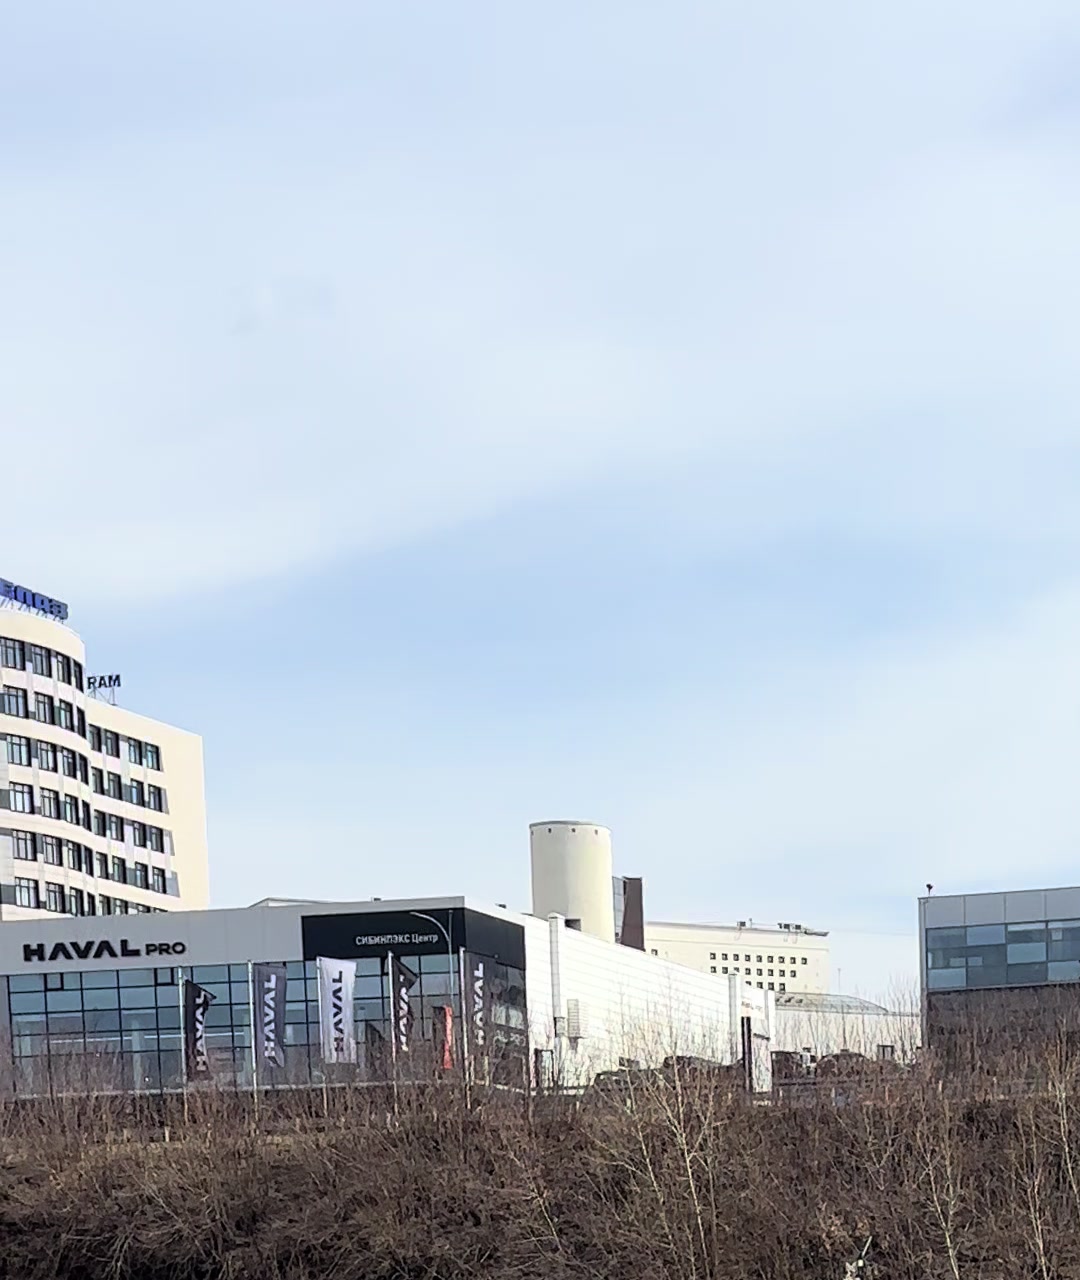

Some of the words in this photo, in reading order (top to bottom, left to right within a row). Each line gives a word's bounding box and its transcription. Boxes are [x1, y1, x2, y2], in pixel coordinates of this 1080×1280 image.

[23, 939, 141, 962] HAVAL
[145, 942, 186, 956] PRO
[264, 974, 277, 1057] HAVAL
[332, 970, 344, 1053] HAVAL
